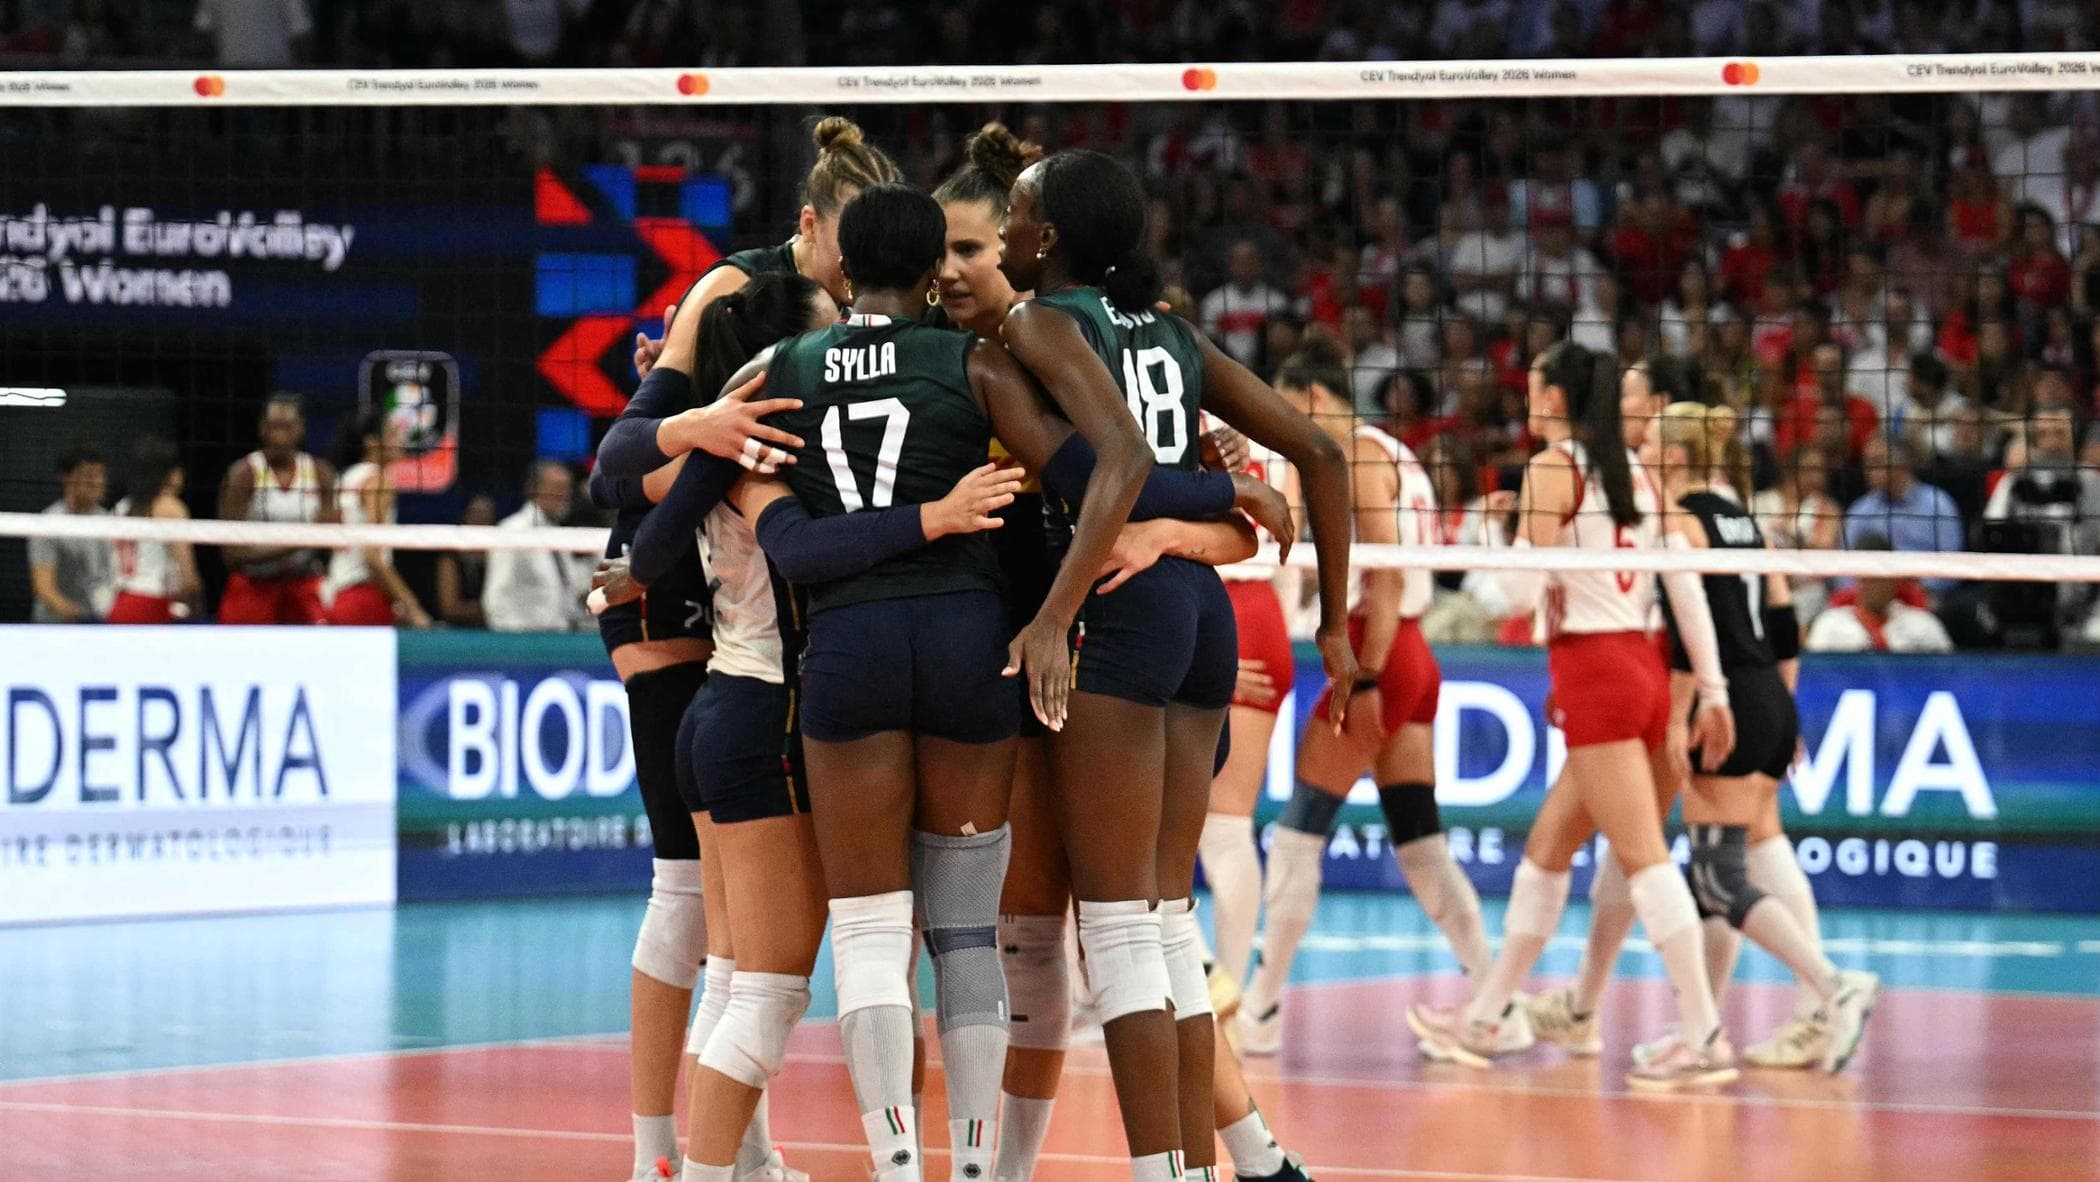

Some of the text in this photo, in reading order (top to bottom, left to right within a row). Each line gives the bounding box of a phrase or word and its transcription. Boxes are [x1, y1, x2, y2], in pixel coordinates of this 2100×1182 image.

[1360, 69, 1577, 83] CEV Trendyol EuroVolley 2026 Women
[1907, 65, 1931, 76] CEV
[1935, 64, 1987, 78] Trendyol
[1990, 62, 2053, 76] EuroVolley
[2057, 62, 2087, 74] 2026
[123, 207, 355, 271] EuroVolley
[60, 257, 232, 307] Women
[824, 341, 896, 383] SYLLA
[1123, 346, 1188, 464] 18
[820, 397, 911, 514] 17
[8, 685, 328, 804] DERMA
[447, 676, 637, 800] BIOD
